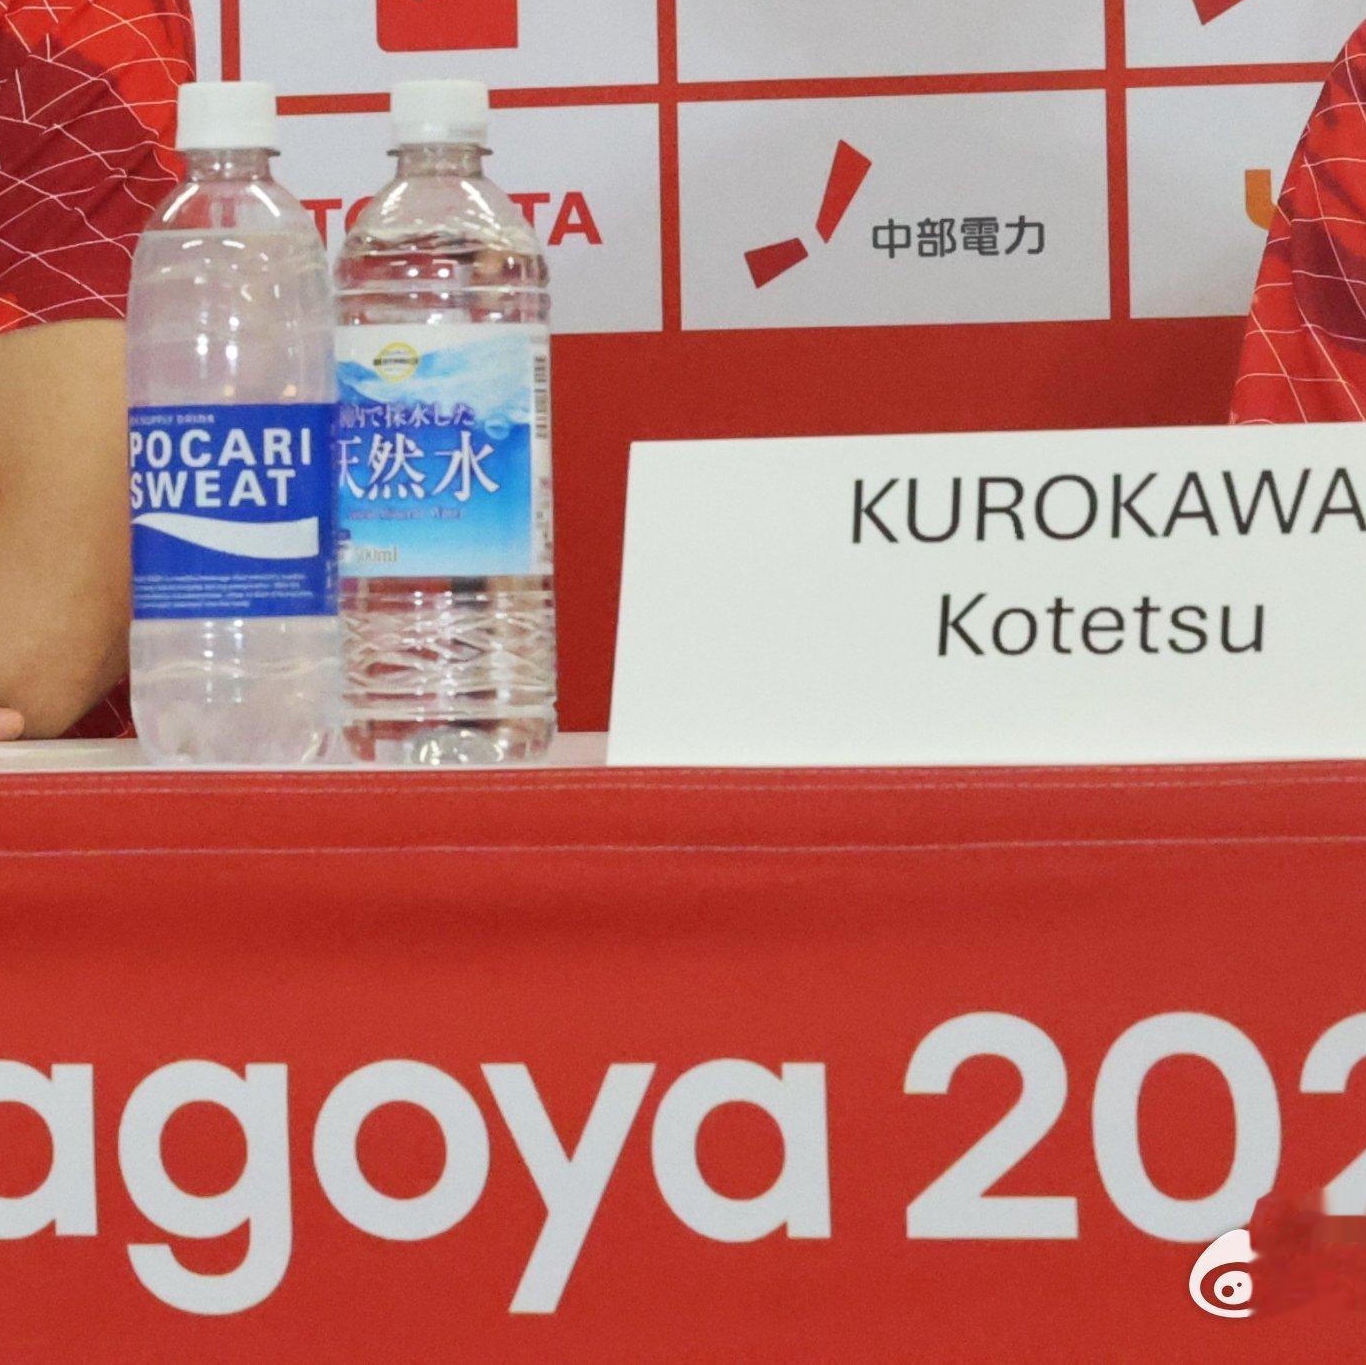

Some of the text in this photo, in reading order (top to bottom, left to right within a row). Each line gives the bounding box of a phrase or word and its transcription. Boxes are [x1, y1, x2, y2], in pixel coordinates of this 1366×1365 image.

[871, 215, 1046, 259] 中部電力
[129, 427, 311, 468] POCARI
[130, 469, 297, 509] SWEAT
[937, 592, 1266, 657] Kotetsu
